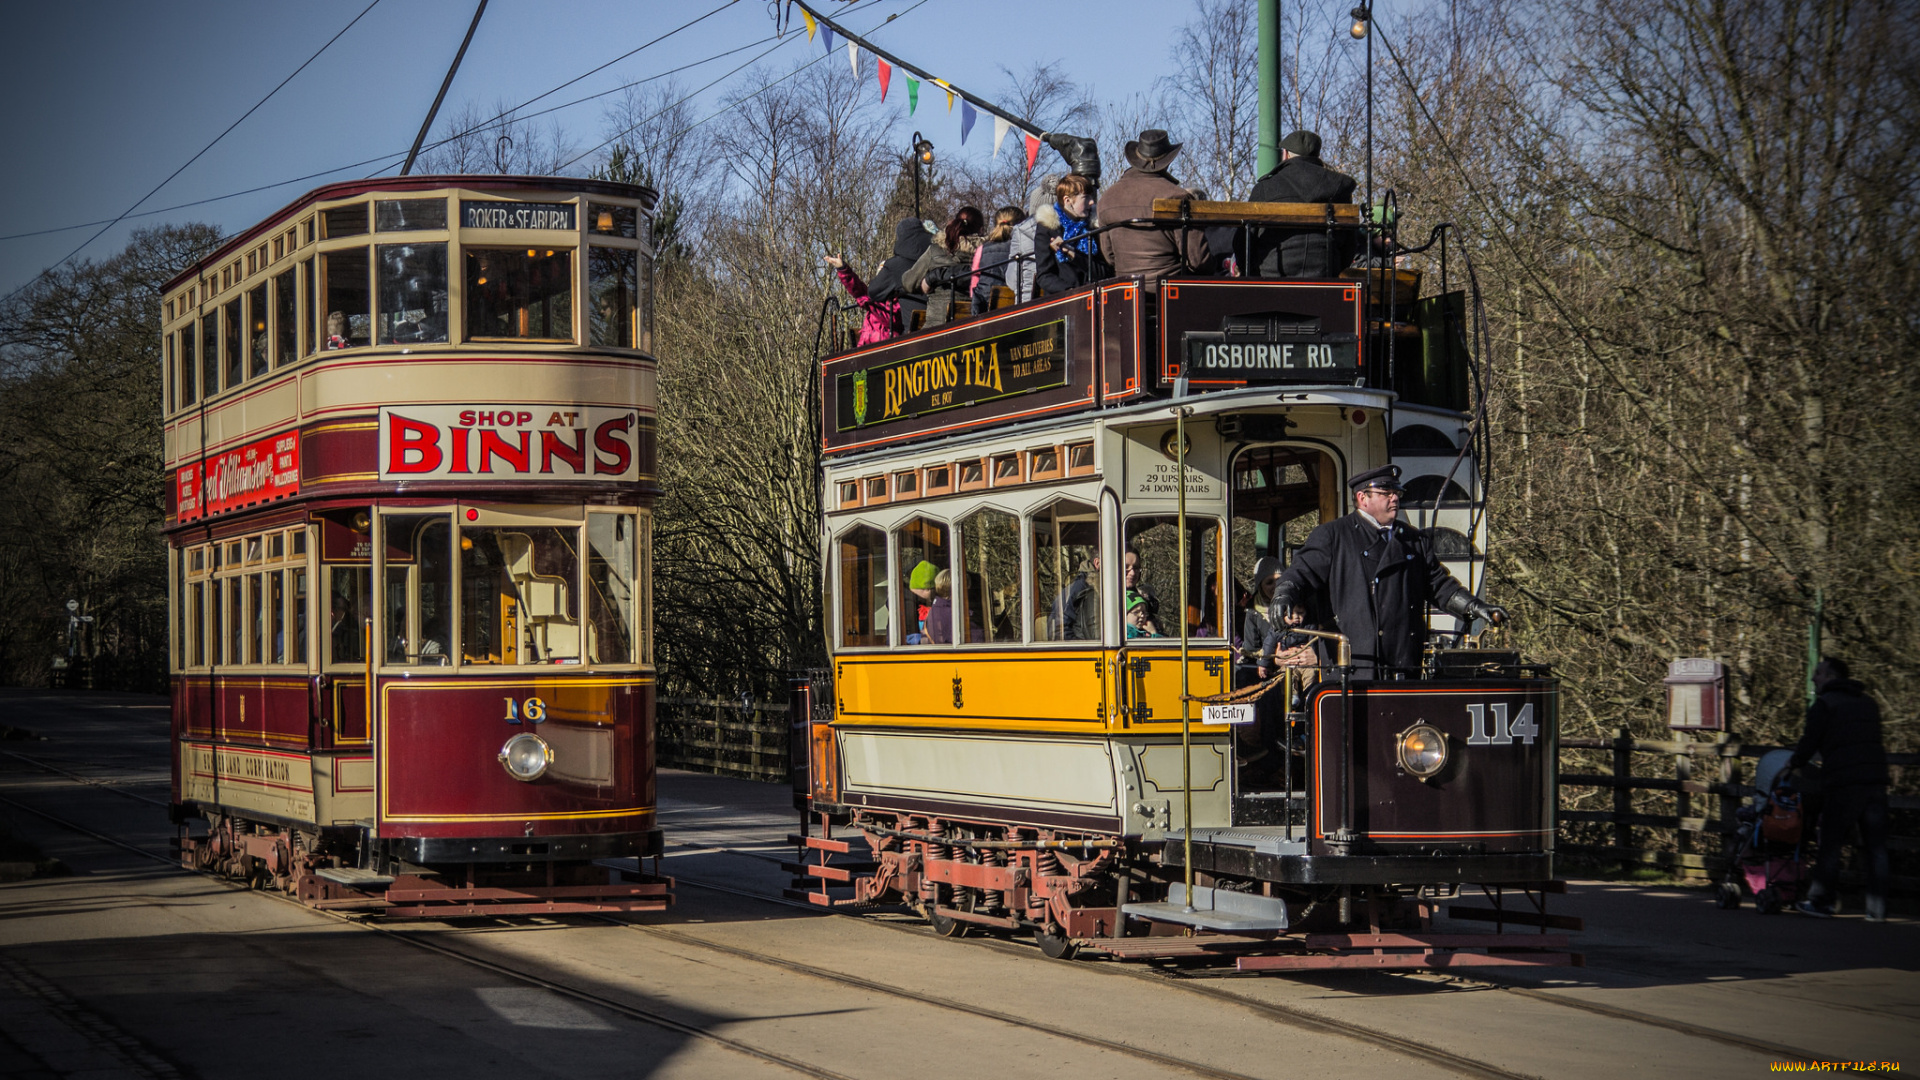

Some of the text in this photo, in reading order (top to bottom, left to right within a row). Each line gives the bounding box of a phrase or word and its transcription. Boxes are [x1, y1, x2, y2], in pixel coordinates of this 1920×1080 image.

[468, 208, 568, 229] ROKER & SEABURN
[1022, 338, 1054, 358] DELIVERIES
[1206, 344, 1337, 368] OSBORNE RD.
[1013, 357, 1051, 378] TO ALL AREAS
[883, 352, 959, 420] RINGTONS
[961, 342, 1004, 394] TEA
[459, 410, 579, 427] SHOP AT
[386, 411, 636, 476] BINNS'
[1146, 474, 1204, 483] 29 UPSAIRS
[1155, 464, 1194, 473] TO SAT
[1139, 484, 1210, 493] 24 DOWNTAIRS
[503, 697, 545, 723] 16
[1208, 706, 1246, 722] No Entry
[1466, 702, 1539, 745] 114
[203, 753, 241, 775] SUERLAND
